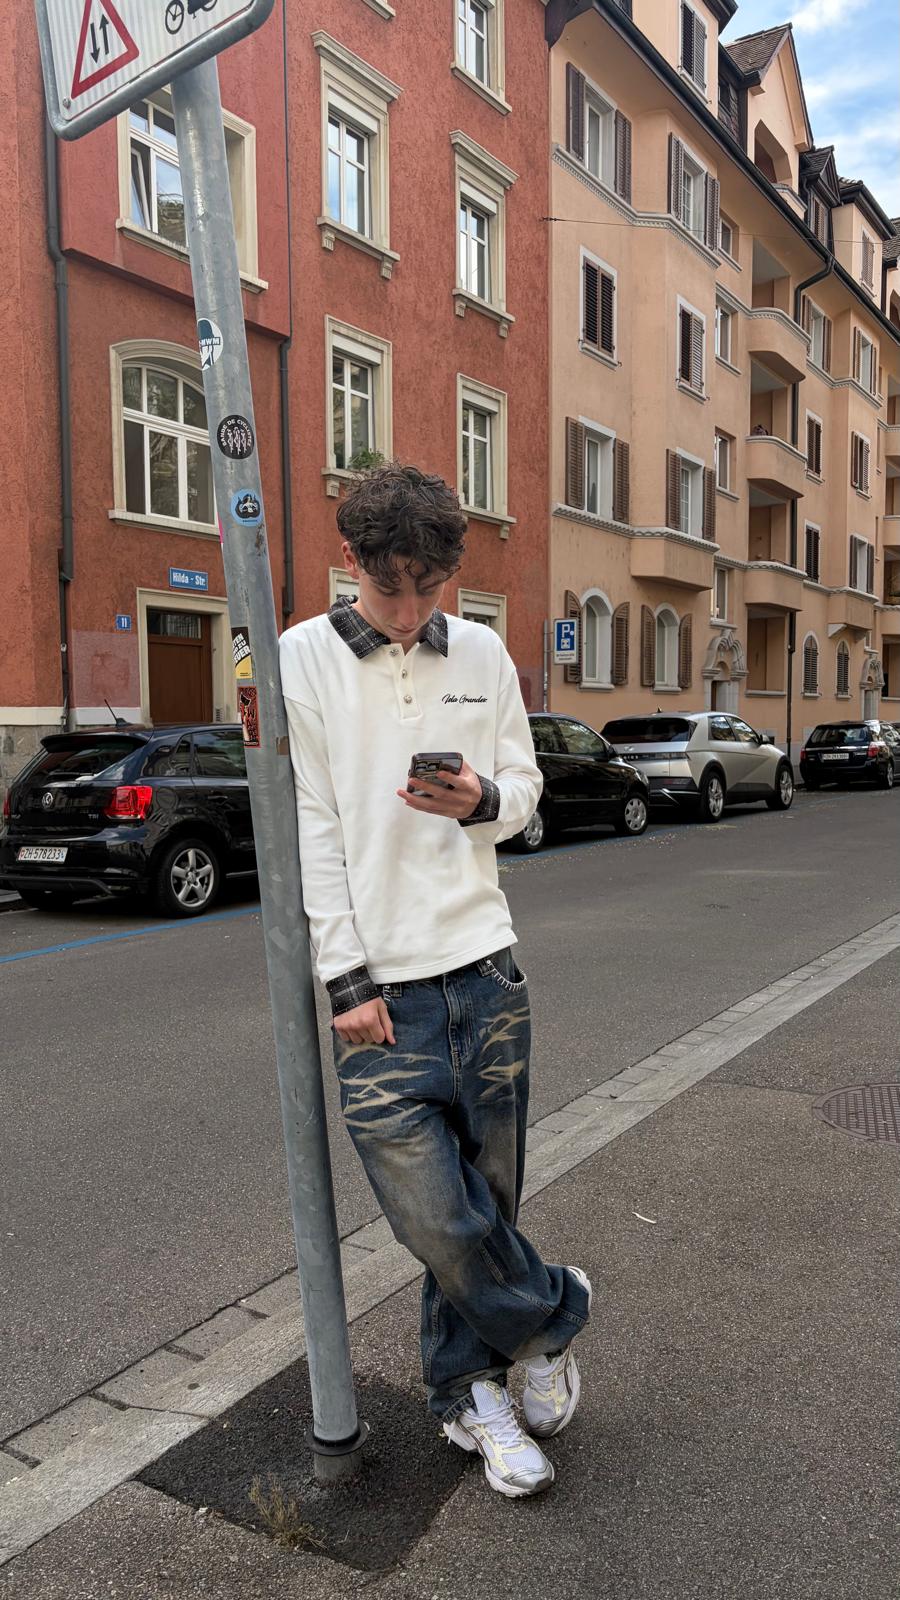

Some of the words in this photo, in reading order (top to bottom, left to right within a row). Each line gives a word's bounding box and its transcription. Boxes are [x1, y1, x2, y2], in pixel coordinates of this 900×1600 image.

[220, 424, 228, 447] BANDE
[172, 571, 189, 584] Hilda
[121, 617, 128, 628] 11
[561, 623, 571, 639] P
